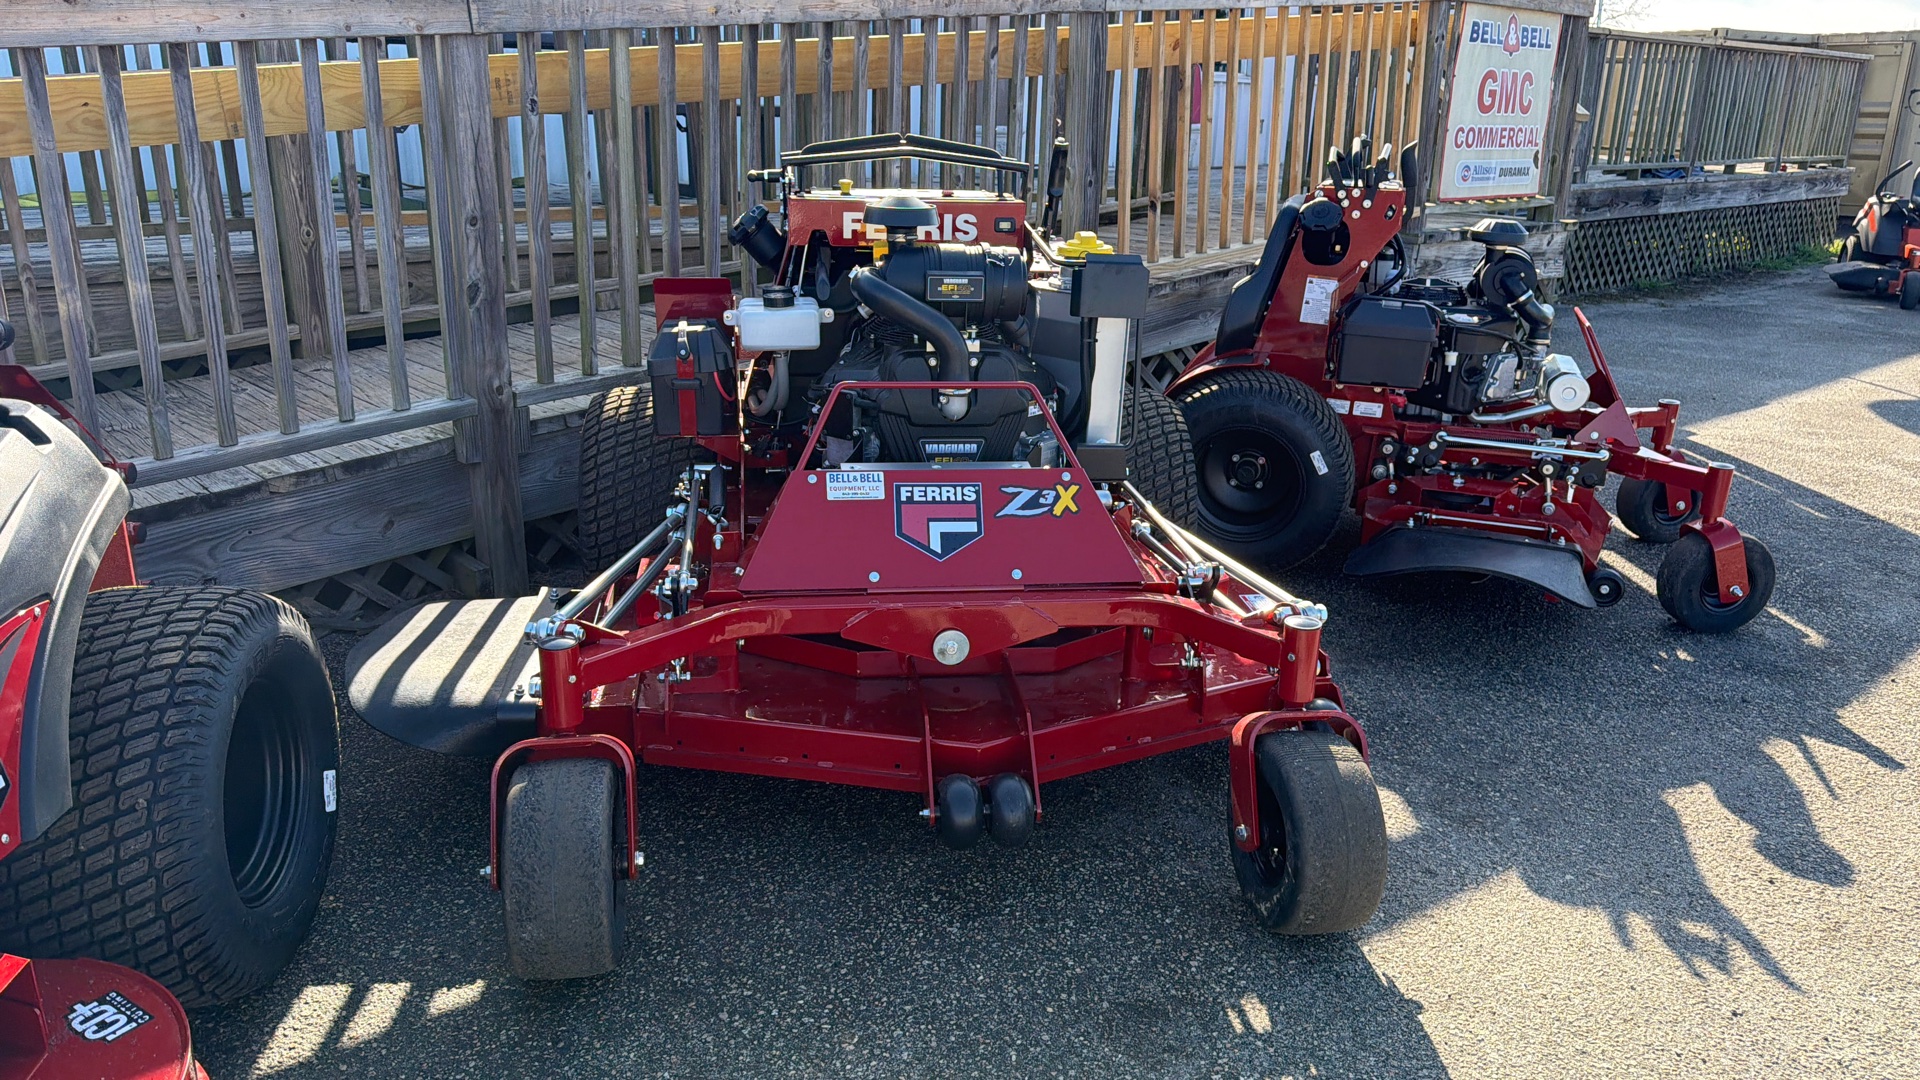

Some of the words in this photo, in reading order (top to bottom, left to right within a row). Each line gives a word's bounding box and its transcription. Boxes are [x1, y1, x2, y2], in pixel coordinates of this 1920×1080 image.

[1469, 21, 1503, 45] BELL
[1520, 27, 1552, 49] BELL
[1477, 69, 1535, 115] GMC
[1454, 126, 1539, 149] COMMERCIAL
[1499, 167, 1531, 178] DURAMAX
[925, 443, 978, 454] VANGUARD
[901, 486, 976, 501] FERRIS
[105, 991, 150, 1024] CUTTING
